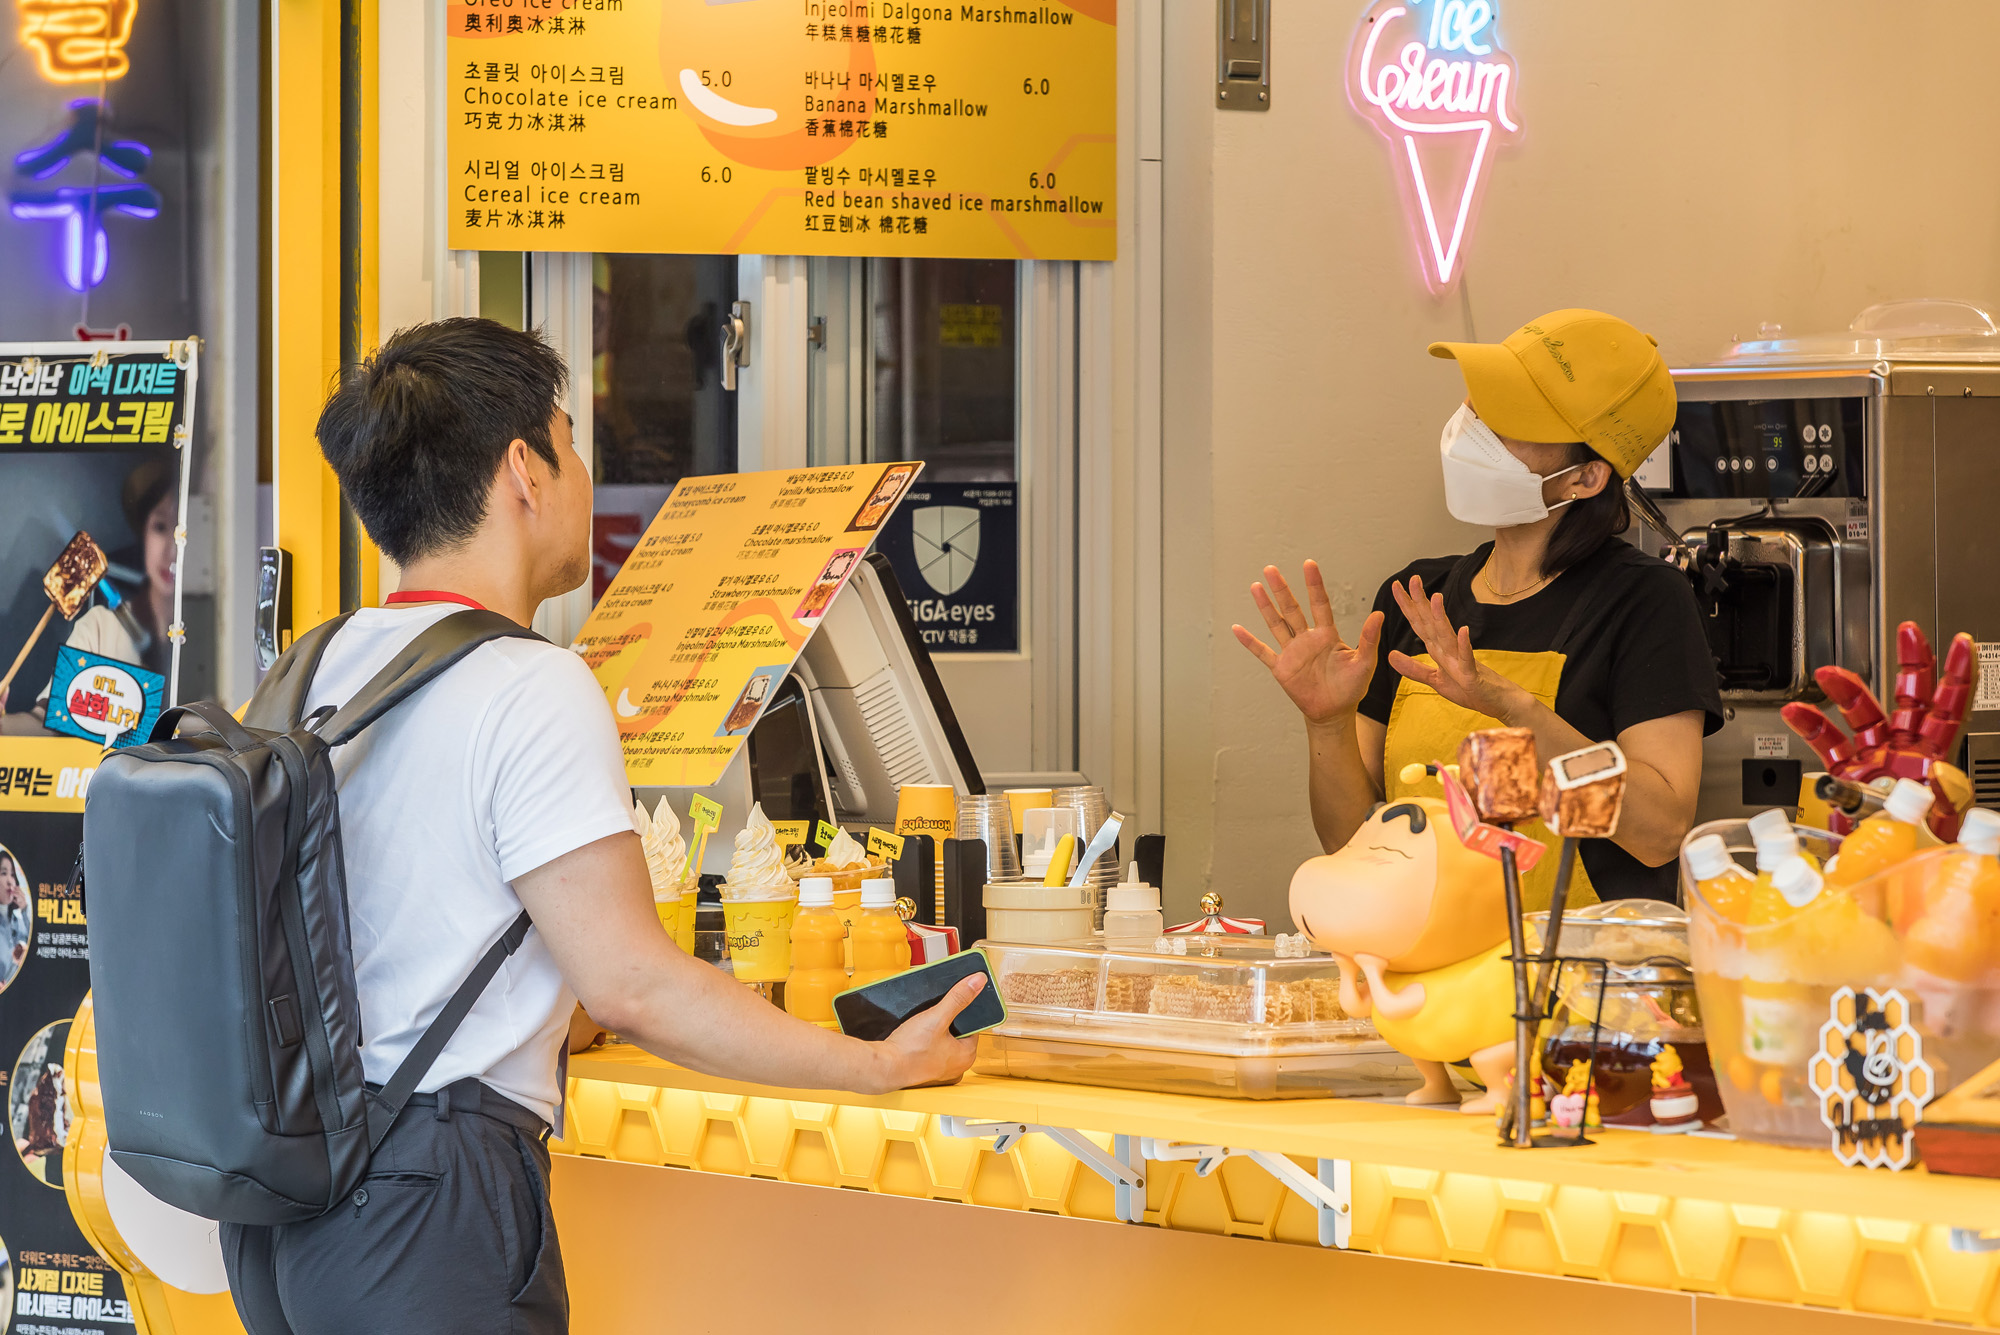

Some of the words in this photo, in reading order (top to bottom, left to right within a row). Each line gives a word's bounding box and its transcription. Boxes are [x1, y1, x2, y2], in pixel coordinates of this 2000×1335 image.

[804, 0, 875, 21] Injeolmi
[883, 2, 952, 24] Dalgona
[961, 6, 1073, 26] Marshmallow
[805, 23, 922, 44] 年糕焦糖棉花糖
[1407, 0, 1493, 55] Ice
[464, 62, 520, 83] 초콜릿
[530, 64, 624, 85] 아이스크림
[1360, 6, 1519, 133] Cream
[701, 70, 732, 88] 5.0
[805, 71, 851, 90] 바나나
[859, 72, 936, 93] 마시멜로우
[1023, 77, 1050, 96] 6.0
[464, 87, 569, 107] Chocolate
[578, 90, 608, 108] ice
[617, 95, 677, 110] cream
[805, 96, 866, 114] Banana
[874, 97, 988, 117] Marshmallow
[464, 112, 586, 132] 巧克力冰淇淋
[805, 118, 888, 138] 香蕉棉花糖
[464, 159, 520, 180] 시리얼
[530, 161, 624, 182] 아이스크림
[701, 166, 732, 184] 6.0
[805, 166, 851, 186] 팥빙수
[859, 168, 936, 188] 마시멜로우
[1029, 172, 1056, 190] 6.0
[464, 185, 530, 203] Cereal
[541, 186, 569, 204] ice
[580, 190, 640, 206] cream
[805, 191, 835, 208] Red
[843, 191, 884, 208] bean
[891, 192, 951, 210] shaved
[959, 194, 983, 211] ice
[990, 195, 1103, 214] marshmallow
[465, 208, 566, 229] 麦片冰淇淋
[805, 214, 870, 233] 红豆刨冰
[879, 216, 928, 235] 棉花糖
[68, 364, 114, 396] 이색
[113, 363, 178, 395] 디저트
[30, 402, 175, 444] 아이스크림
[840, 471, 854, 480] 6.0
[723, 482, 736, 492] 6.0
[778, 486, 803, 496] Vanilla
[803, 484, 854, 494] Marshmallow
[670, 497, 712, 508] Honeycomb
[712, 496, 722, 504] ice
[723, 496, 746, 504] cream
[806, 522, 820, 531] 6.0
[744, 537, 782, 548] Chocolate
[781, 534, 833, 544] marshmallow
[636, 549, 658, 558] Honey
[660, 547, 670, 556] ice
[670, 548, 693, 556] cream
[766, 574, 780, 584] 6.0
[710, 588, 752, 598] Strawberry
[752, 586, 804, 596] marshmallow
[603, 599, 620, 608] Soft
[620, 598, 630, 606] ice
[907, 600, 950, 623] iGA
[950, 604, 996, 626] eyes
[759, 626, 773, 634] 6.0
[920, 629, 946, 644] CTV
[600, 650, 622, 658] cream
[676, 641, 706, 652] Injeolmi
[706, 640, 737, 651] Dalgona
[736, 638, 788, 648] Marshmallow
[704, 679, 718, 688] 6.0
[642, 694, 671, 703] Banana
[670, 692, 720, 702] Marshmallow
[670, 732, 684, 742] 6.0
[624, 746, 643, 755] bean
[642, 745, 670, 755] shaved
[670, 746, 680, 754] ice
[681, 745, 733, 755] marshmallow
[902, 816, 951, 831] Honeyba
[61, 1270, 104, 1296] 디저트
[16, 1292, 72, 1319] 마시멜로
